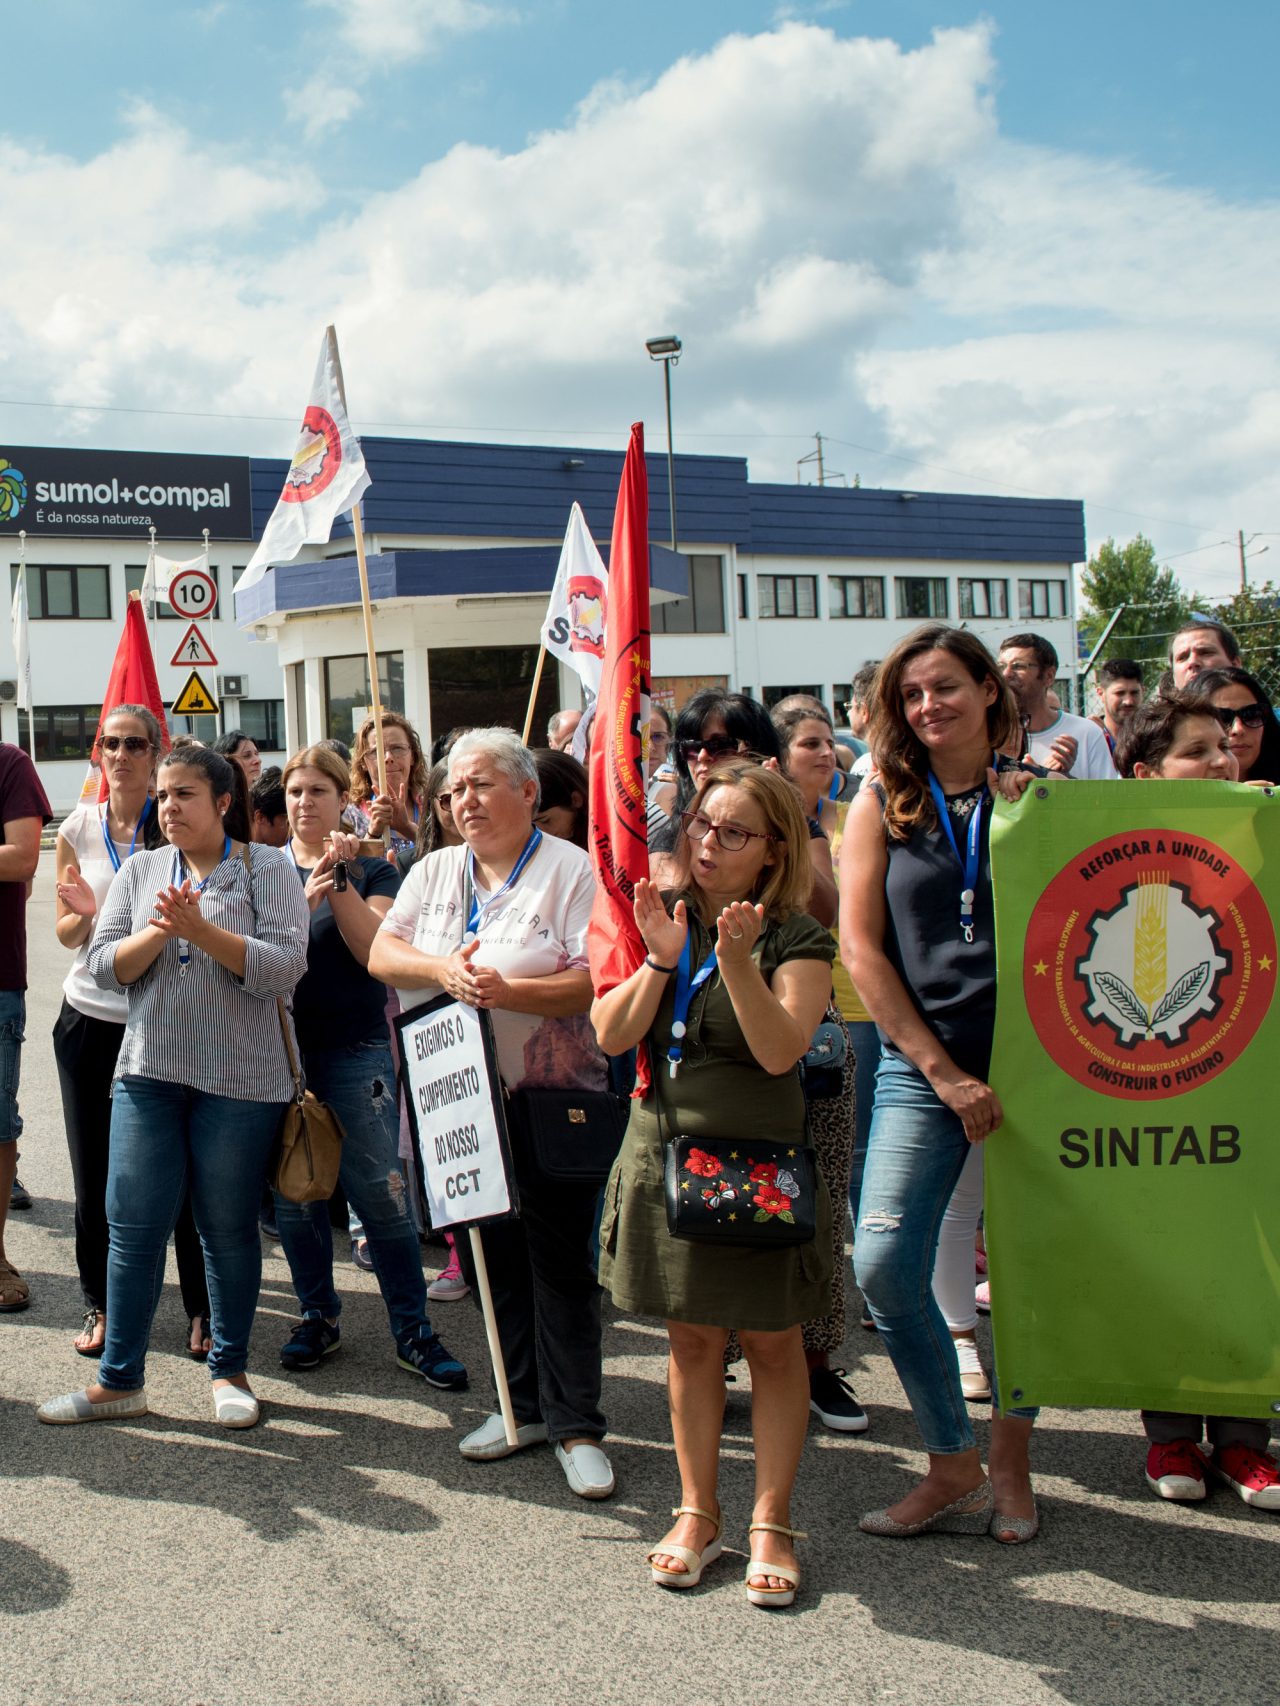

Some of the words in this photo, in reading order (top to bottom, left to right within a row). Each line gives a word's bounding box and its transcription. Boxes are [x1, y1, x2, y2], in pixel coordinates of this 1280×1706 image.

[35, 478, 230, 512] sumol+compal
[36, 509, 44, 523] É
[48, 511, 63, 524] da
[66, 513, 99, 524] nossa
[102, 513, 154, 526] natureza.
[180, 584, 205, 604] 10
[1079, 839, 1151, 881] REFORÇAR
[1156, 839, 1166, 853] A
[1171, 840, 1230, 878] UNIDADE
[1058, 909, 1080, 949] SINDICATO
[1228, 901, 1247, 938] PORTUGAL
[1055, 950, 1065, 965] DOS
[1242, 938, 1251, 949] DE
[1242, 949, 1252, 984] TABACOS
[1229, 986, 1246, 1021] BEBIDAS
[415, 1018, 455, 1062] EXIGIMOS
[456, 1014, 464, 1043] O
[1069, 1025, 1078, 1036] DA
[1076, 1034, 1115, 1067] AGRICULTURA
[1121, 1061, 1136, 1071] DAS
[1180, 1055, 1190, 1065] DE
[1087, 1060, 1158, 1091] CONSTRUIR
[1161, 1074, 1172, 1088] O
[1175, 1050, 1225, 1085] FUTURO
[418, 1064, 480, 1116] CUMPRIMENTO
[434, 1135, 447, 1166] DO
[446, 1123, 480, 1161] NOSSO
[1059, 1124, 1242, 1169] SINTAB
[445, 1168, 481, 1200] CCT
